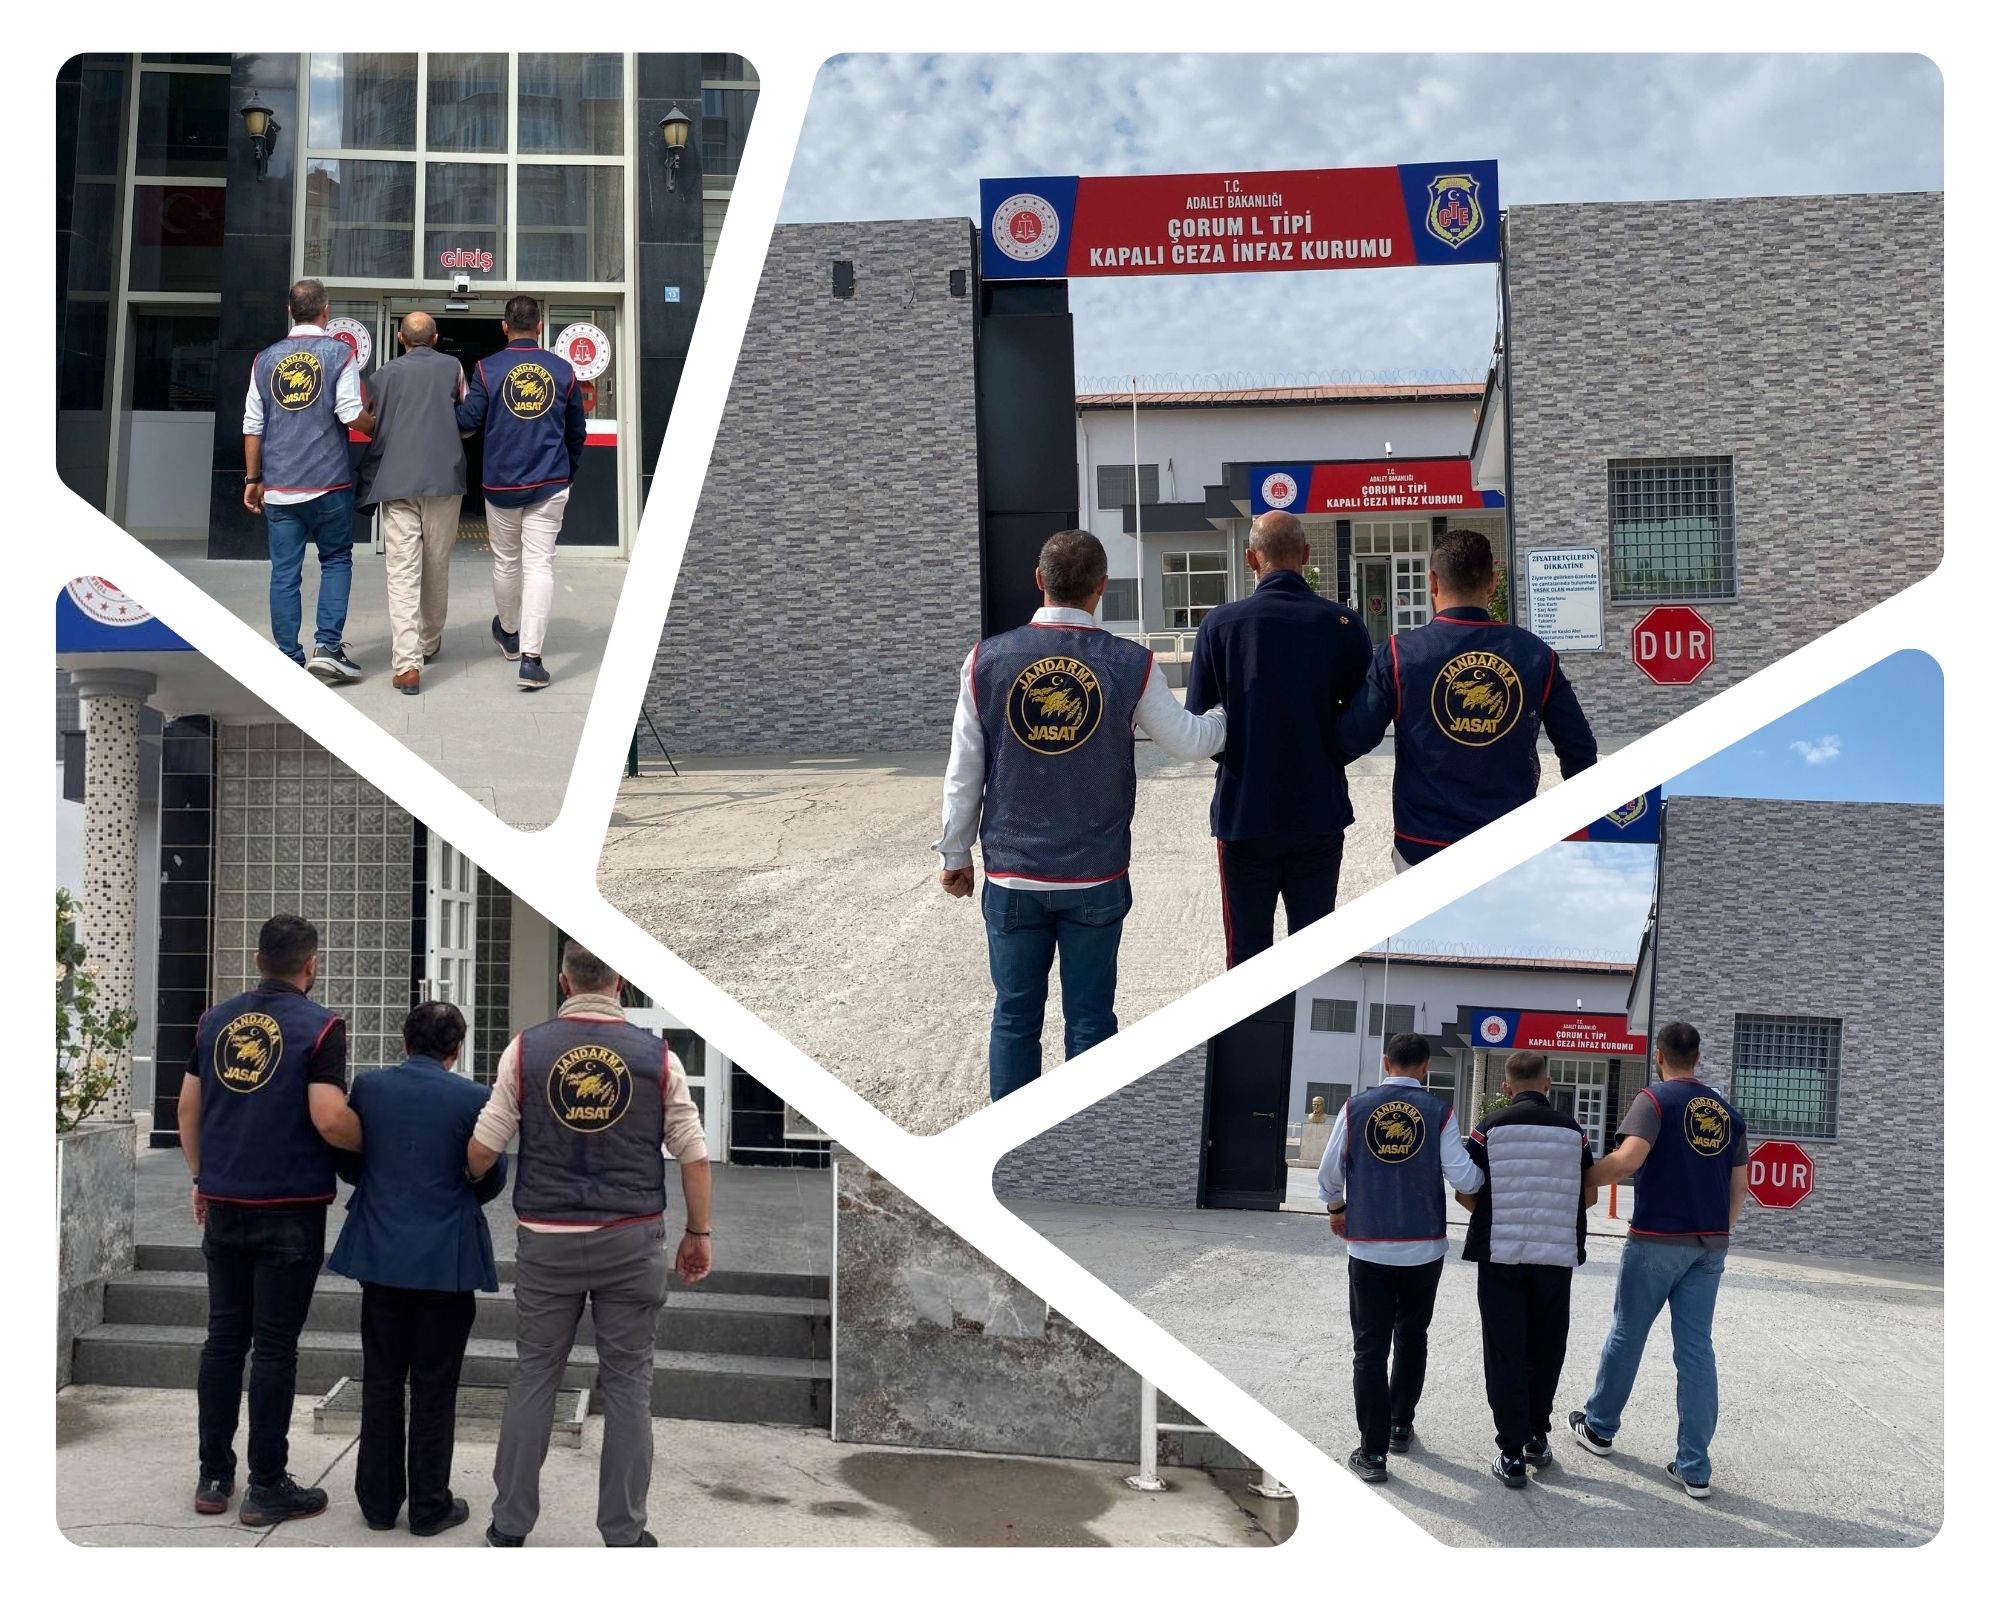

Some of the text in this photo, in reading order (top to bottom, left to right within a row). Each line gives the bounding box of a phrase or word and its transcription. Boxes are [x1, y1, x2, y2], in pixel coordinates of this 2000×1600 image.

[1224, 180, 1243, 193] T.C.
[1186, 192, 1282, 210] ADALET BAKANLIĞI
[1439, 202, 1469, 228] CTE
[1168, 210, 1312, 243] ÇORUM L TİPİ
[441, 248, 493, 272] GİRİŞ
[1090, 238, 1393, 267] KAPALI CEZA İNFAZ KURUMU
[277, 354, 320, 373] JANDARMA
[509, 365, 551, 384] JANDARMA
[282, 393, 310, 404] JASAT
[514, 401, 542, 411] JASAT
[1370, 474, 1414, 483] ADALET BAKANLIĞI
[1362, 483, 1427, 497] ÇORUM L TİPİ
[1326, 494, 1463, 508] KAPALI CEZA İNFAZ KURUMU
[1544, 562, 1584, 571] DİKKATİNE
[1640, 630, 1705, 660] DUR
[1019, 659, 1096, 693] JANDARMA
[1443, 655, 1517, 688] JANDARMA
[1028, 725, 1079, 741] JASAT
[1450, 717, 1500, 733] JASAT
[228, 1014, 280, 1045] JANDARMA
[1556, 1030, 1583, 1039] ÇORUM
[1592, 1030, 1607, 1041] TİPİ
[1528, 1038, 1634, 1051] KAPALI CEZA İNFAZ KURUMU
[557, 1048, 626, 1077] JANDARMA
[224, 1066, 261, 1083] JASAT
[565, 1106, 611, 1120] JASAT
[1372, 1103, 1421, 1124] JANDARMA
[1689, 1098, 1729, 1122] JANDARMA
[1377, 1144, 1411, 1154] JASAT
[1692, 1135, 1721, 1149] JASAT
[1750, 1160, 1808, 1189] DUR
